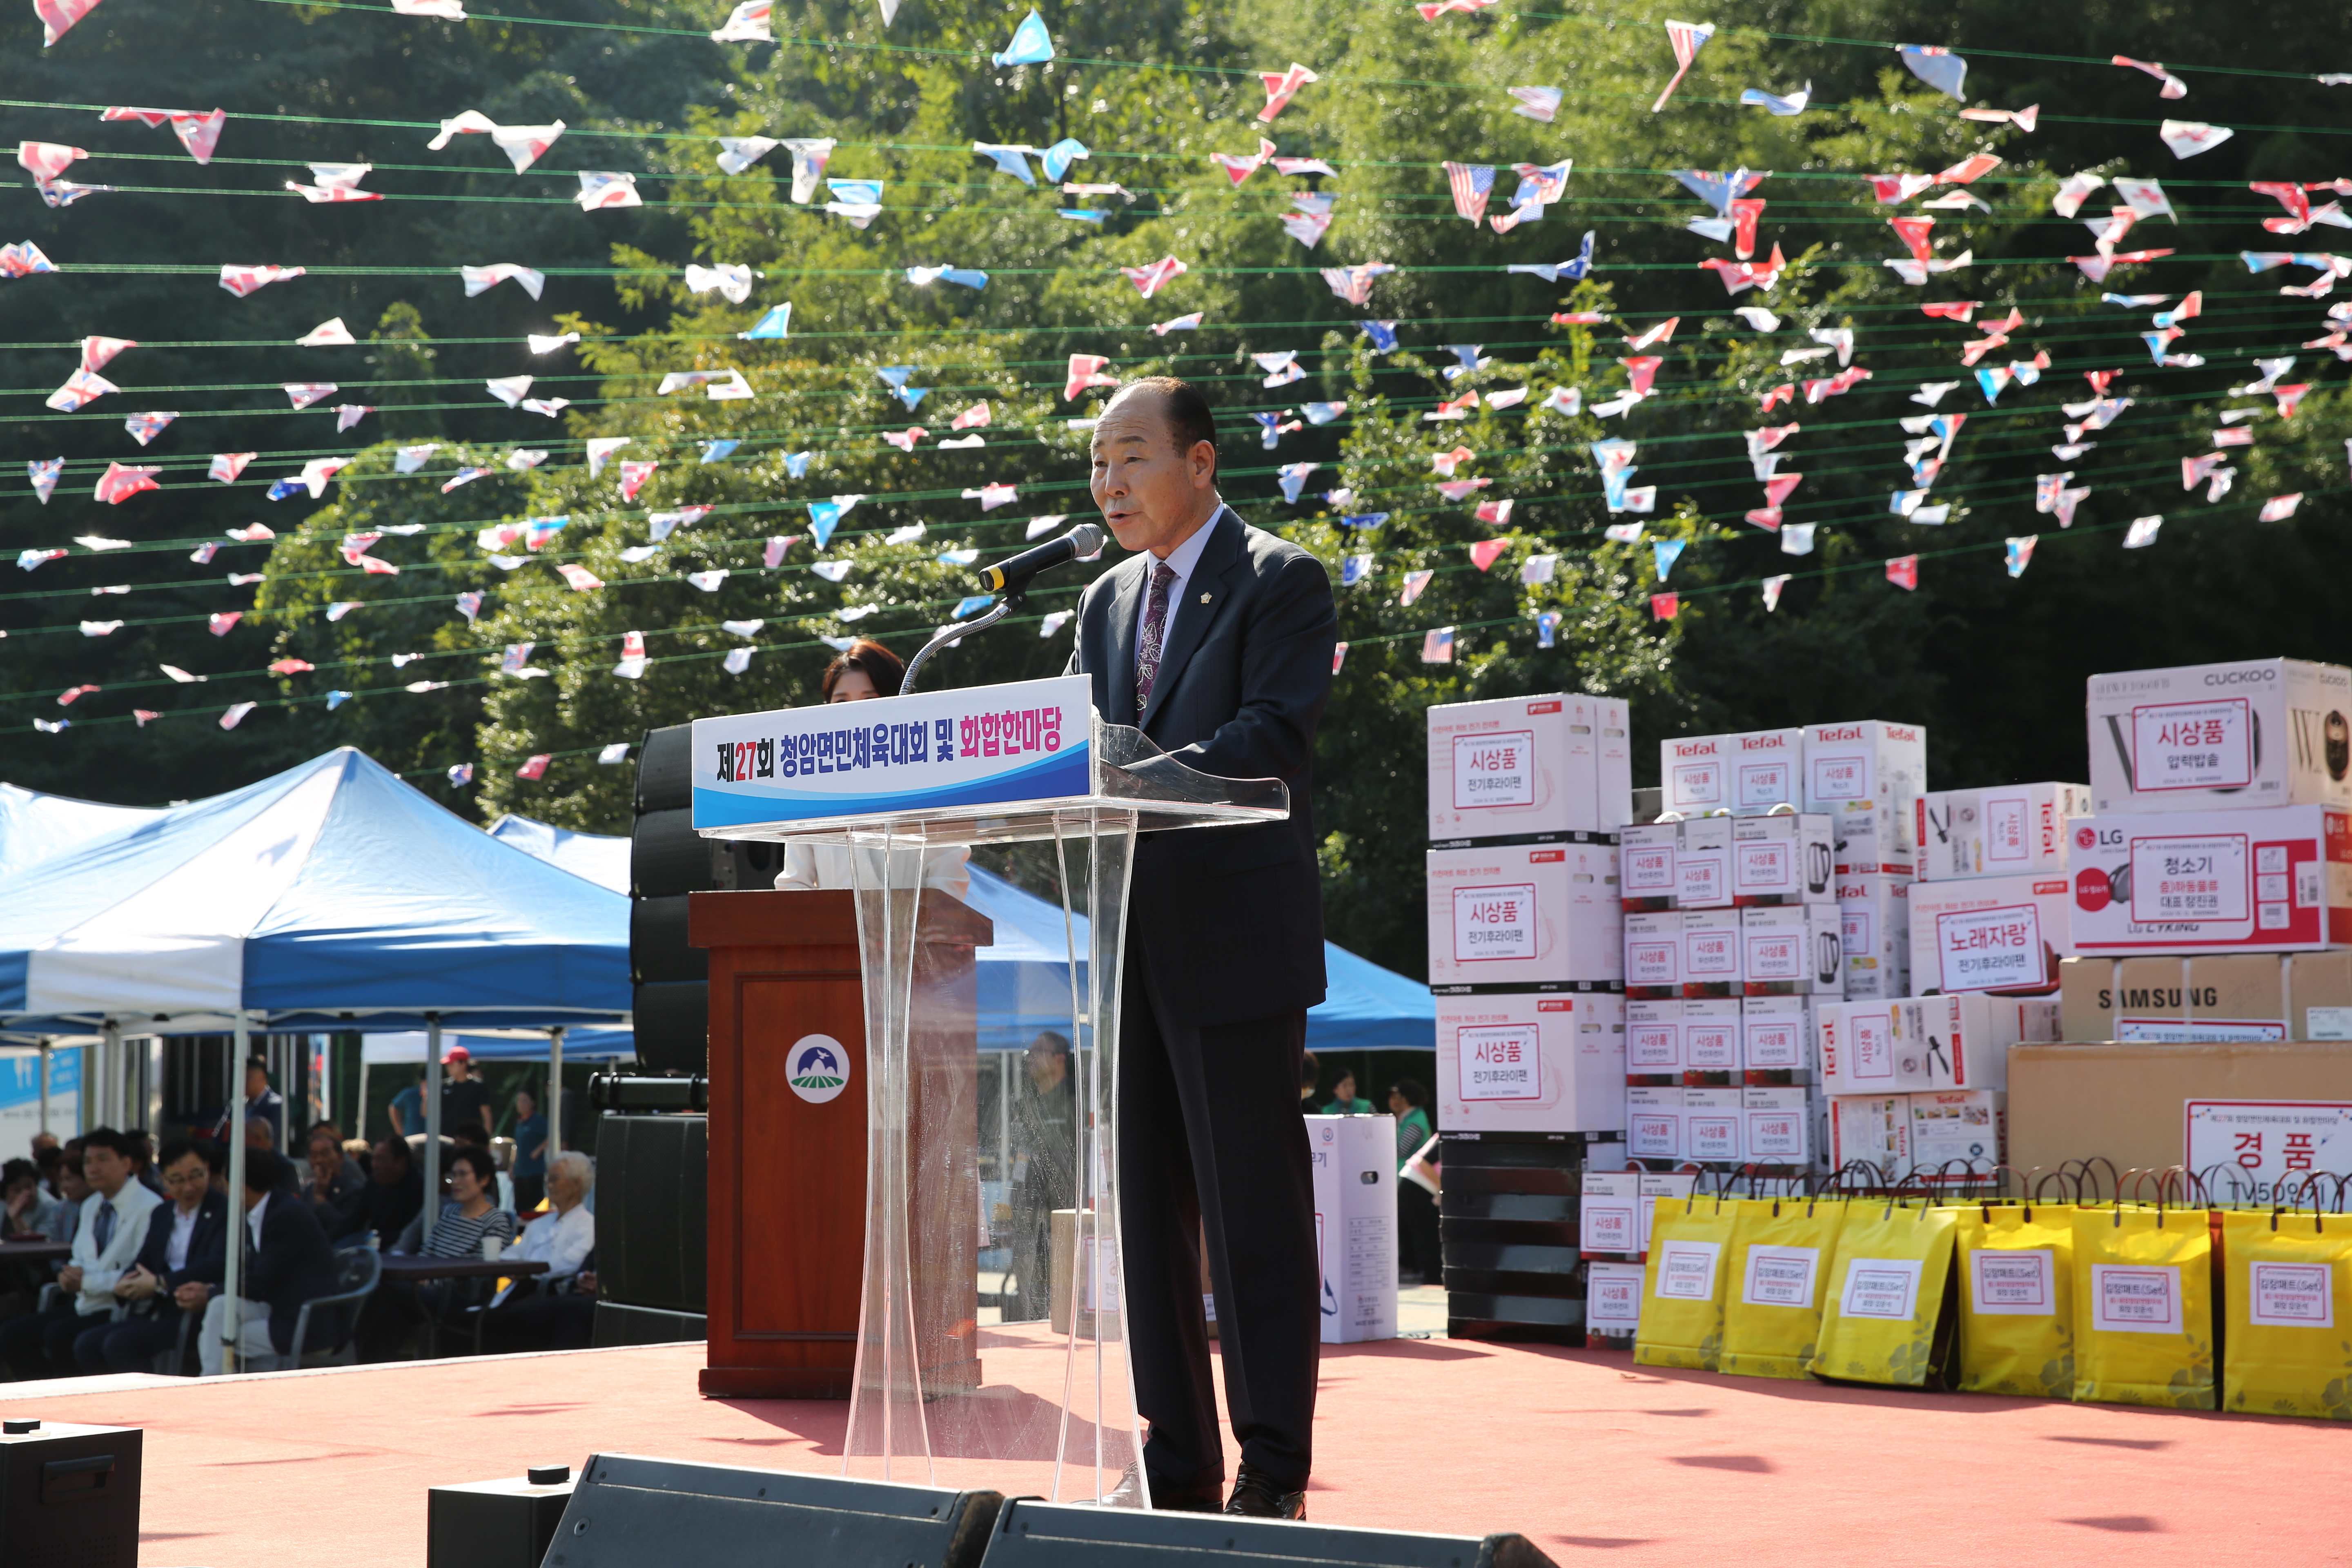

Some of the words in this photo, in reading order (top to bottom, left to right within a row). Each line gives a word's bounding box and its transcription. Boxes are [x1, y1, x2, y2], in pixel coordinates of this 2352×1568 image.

[2204, 669, 2275, 686] CUCKOO
[1740, 735, 1786, 750] Tefal
[1817, 726, 1864, 742] Tefal
[1886, 726, 1918, 743] Tefal
[2157, 719, 2224, 747] 시상품
[717, 738, 774, 782] 제27회
[780, 721, 928, 778] 청암면민체육대회
[935, 718, 954, 762] 및
[960, 706, 1061, 758] 화합한마당
[1674, 742, 1718, 757] Tefal
[1470, 748, 1517, 771] 시상품
[2166, 752, 2219, 770] 압력밥솥
[1468, 775, 1522, 791] 전기후라이팬
[2040, 799, 2055, 857] Tefal
[2100, 830, 2123, 845] LG
[2165, 856, 2213, 875] 청소기
[1471, 901, 1517, 923] 시상품
[1468, 929, 1523, 944] 전기후라이팬
[1950, 923, 2027, 951] 노래자랑
[1958, 953, 2027, 973] 전기후라이팬
[2098, 987, 2217, 1009] SAMSUNG
[1475, 1041, 1521, 1063] 시상품
[1823, 1020, 1836, 1080] Tefal
[1473, 1069, 1528, 1084] 전기후라이팬
[2227, 1181, 2325, 1205] TV50인치
